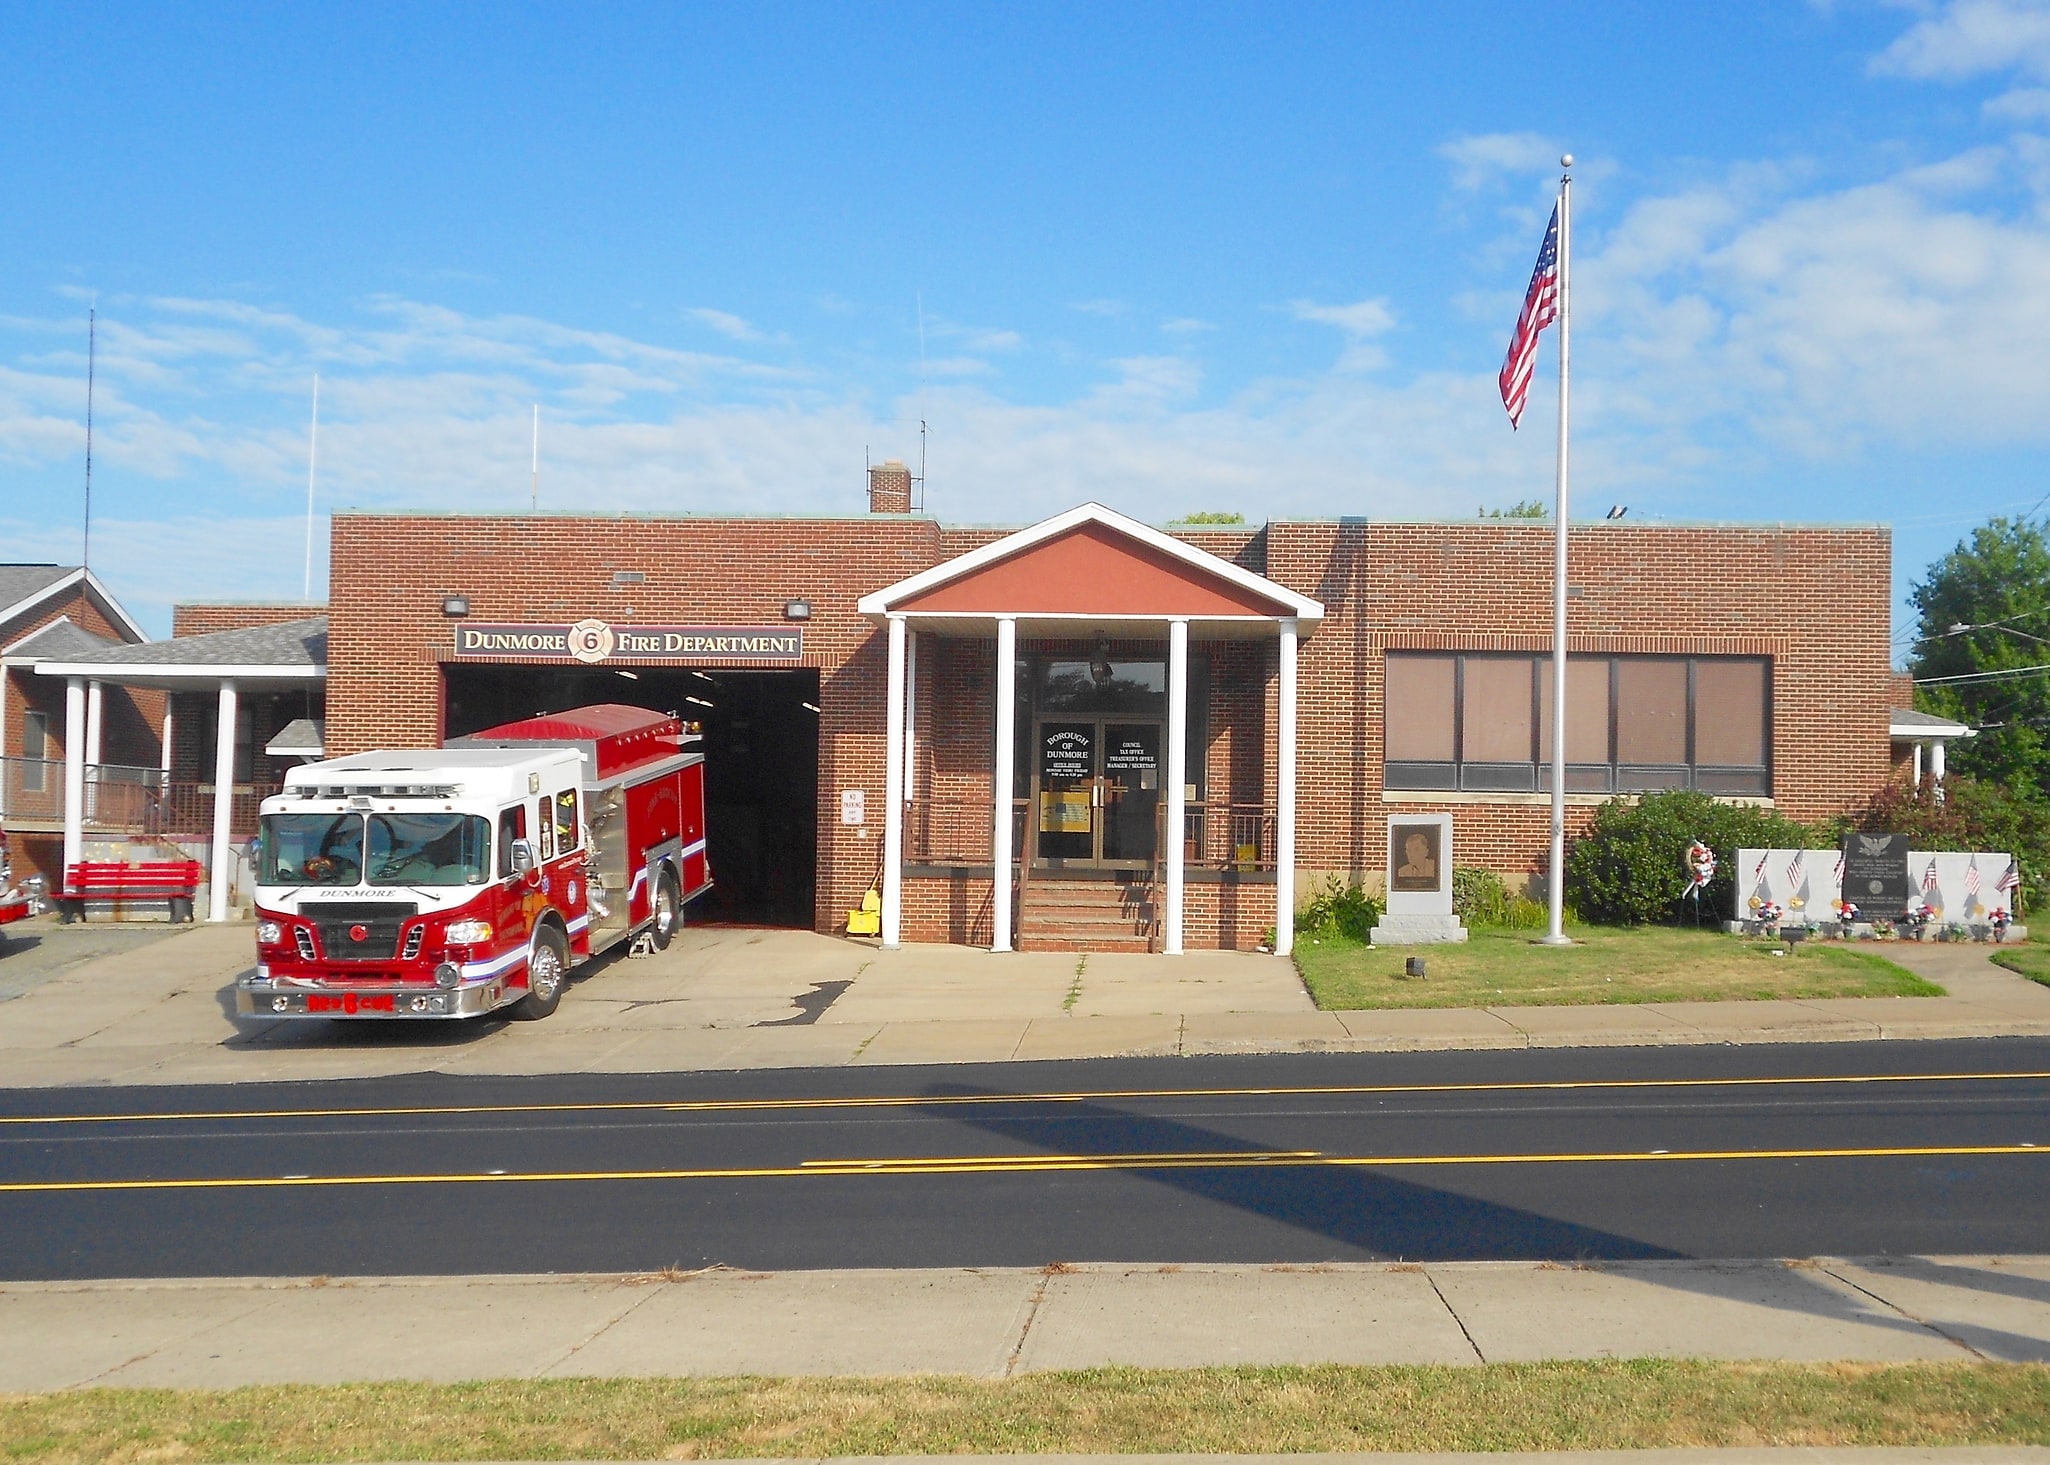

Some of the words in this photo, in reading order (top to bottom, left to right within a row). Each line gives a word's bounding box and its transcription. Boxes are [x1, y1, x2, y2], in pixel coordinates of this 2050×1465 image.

[464, 630, 564, 651] DUNMORE
[583, 632, 598, 650] 6
[616, 633, 660, 652] FIRE
[664, 633, 798, 653] DEPARTMENT
[1047, 732, 1089, 746] BOROUGH
[1061, 742, 1073, 750] OF
[1046, 751, 1089, 759] DUNMORE
[319, 889, 396, 897] DUNMORE
